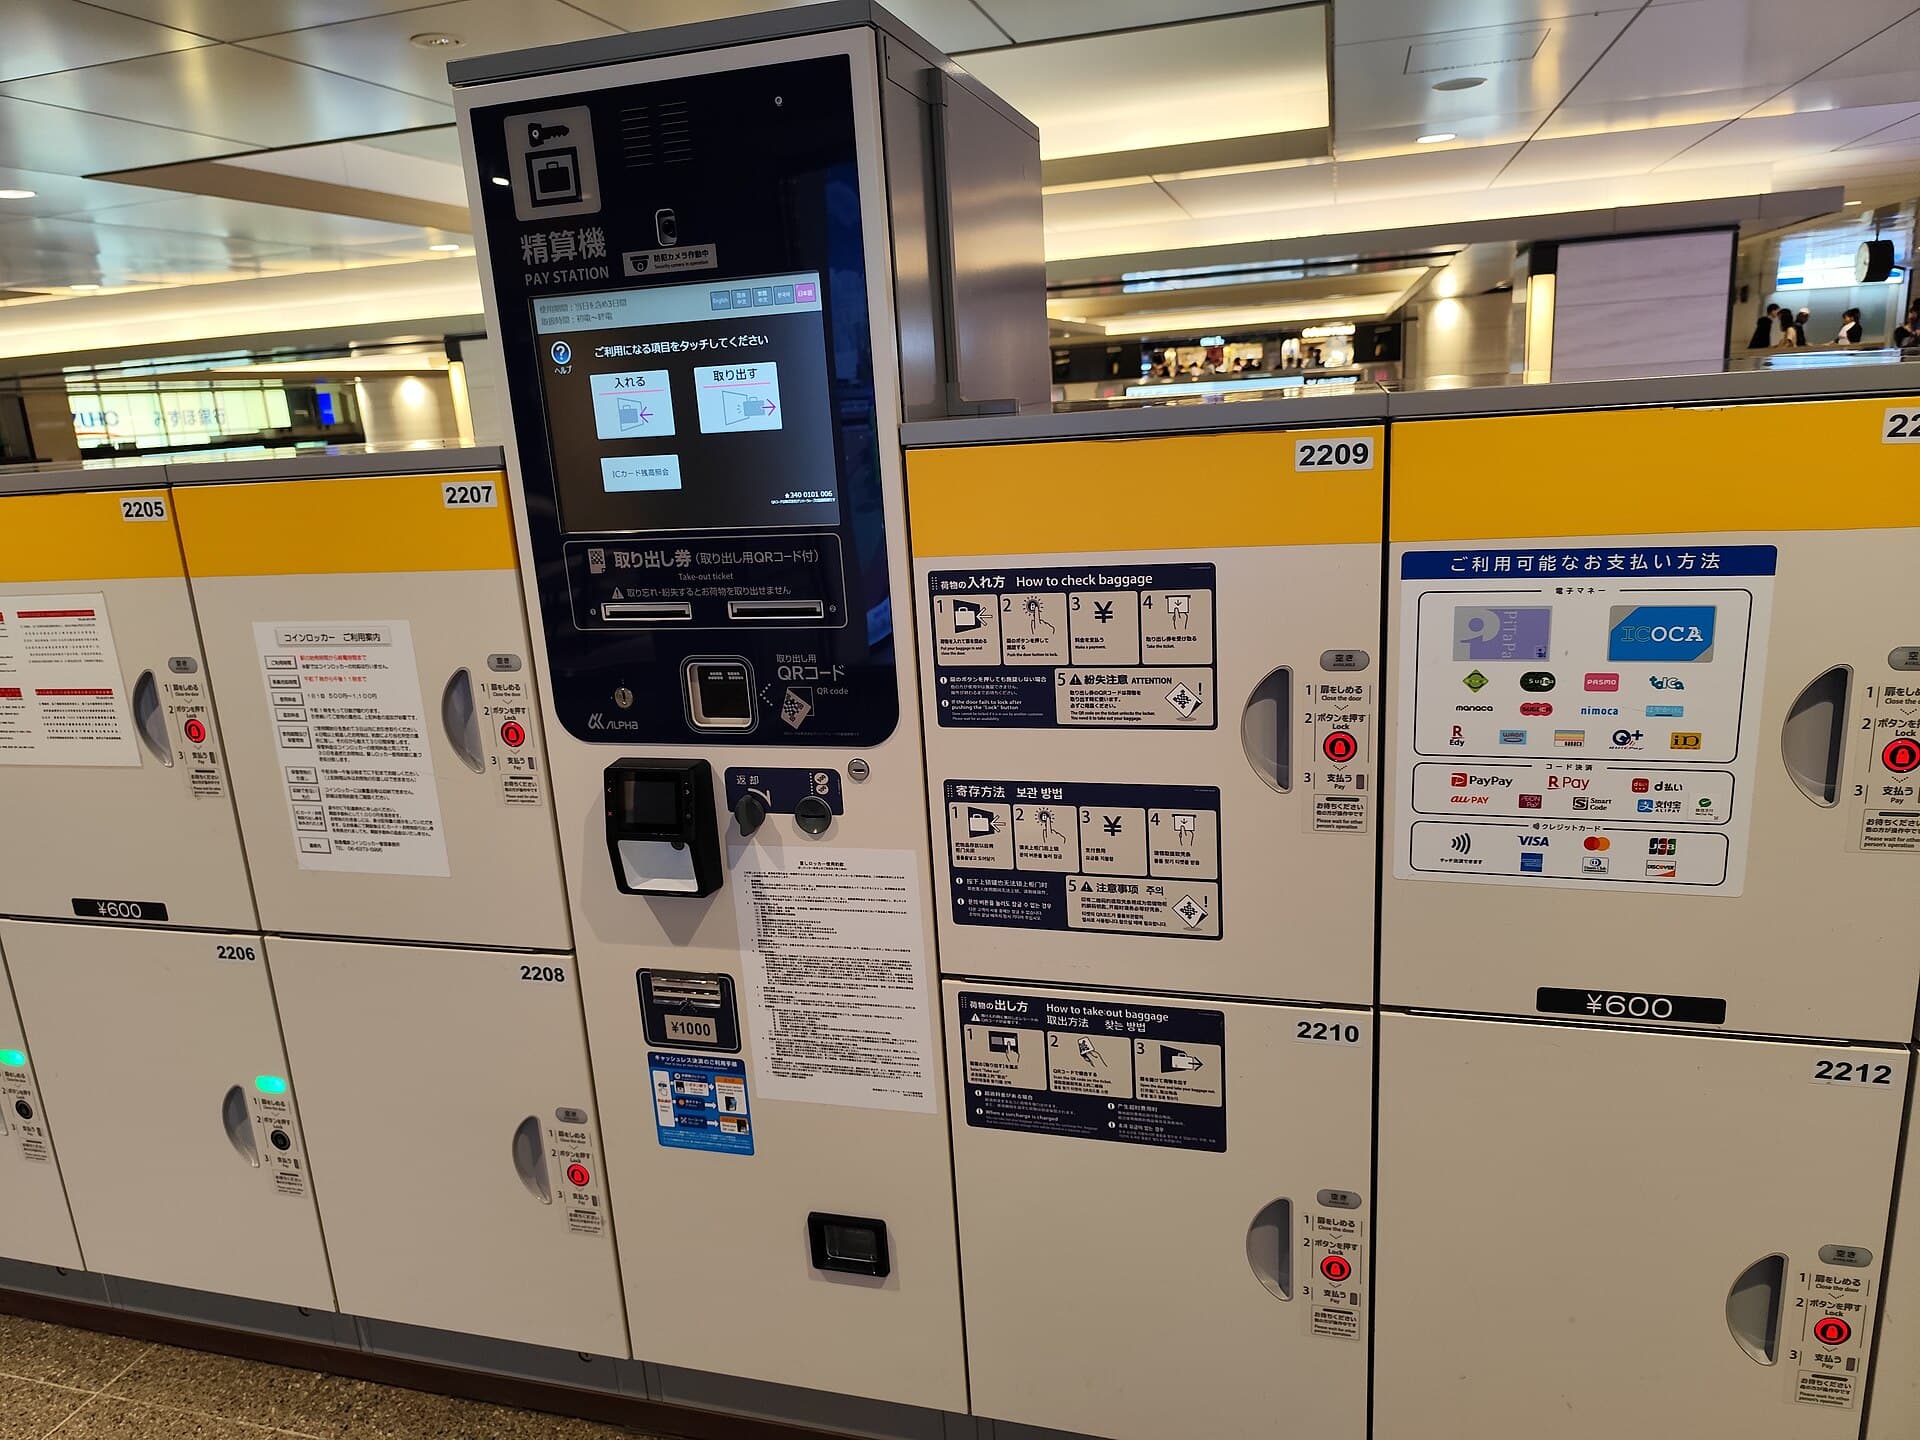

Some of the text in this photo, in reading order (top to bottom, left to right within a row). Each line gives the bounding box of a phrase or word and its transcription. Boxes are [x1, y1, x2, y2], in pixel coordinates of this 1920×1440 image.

[520, 227, 607, 266] 精算機
[525, 266, 609, 286] PAY STATION
[594, 334, 769, 359] ご利用になる項目をタッチしてください
[554, 365, 572, 375] ヘルプ
[713, 367, 757, 383] 取り出す
[614, 376, 646, 389] 入れる
[1299, 442, 1369, 466] 2209
[445, 485, 493, 505] 2207
[122, 501, 165, 519] 2205
[1451, 552, 1721, 572] ご利用可能なお支払い方法
[678, 572, 734, 581] Take-out ticket
[940, 574, 1153, 590] 荷物の入れ方 How to check baggage
[1555, 587, 1606, 595] 電子マネー
[936, 600, 943, 613] 1
[1003, 598, 1012, 612] 2
[1071, 597, 1081, 611] 3
[1143, 595, 1153, 610] 4
[284, 633, 381, 642] コインロッカー ご利用案内
[1502, 610, 1518, 658] PiTaPa
[1621, 626, 1704, 642] ICOCA
[776, 654, 816, 664] 取り出し用
[777, 664, 845, 682] QRコード
[1058, 673, 1172, 686] 5 紛失注意 ATTENTION
[491, 683, 521, 692] 扉をしめる
[816, 687, 849, 695] QR code
[1320, 685, 1364, 694] 扉をしめる
[492, 707, 526, 715] ボタンを押す
[1581, 706, 1619, 716] nimoca
[1304, 713, 1366, 724] 2 ボタンを押す
[1861, 718, 1872, 730] 2
[1453, 725, 1462, 737] R
[1449, 739, 1465, 747] Edy
[1673, 735, 1699, 747] iD
[507, 757, 525, 765] 支払う
[1546, 763, 1593, 771] コード決済
[1303, 773, 1352, 783] 3 支払う
[1469, 775, 1513, 788] PayPay
[1548, 775, 1590, 790] R Pay
[956, 785, 1063, 800] 寄存方法 보관 방법
[1334, 783, 1345, 791] Pay
[1654, 781, 1683, 792] d払い
[1854, 785, 1914, 796] 3 支払う
[1450, 795, 1489, 804] au PAY
[1655, 800, 1682, 809] 支付宝
[1890, 797, 1904, 805] Pay
[1316, 802, 1364, 811] お待ちください
[1016, 808, 1025, 821] 2
[1082, 811, 1091, 823] 3
[1150, 813, 1161, 826] 4
[1542, 824, 1601, 832] クレジットカード
[1517, 835, 1550, 847] VISA
[1649, 840, 1676, 853] JCB
[1068, 880, 1164, 896] 5 注意事项 주의
[97, 901, 142, 919] ¥600
[216, 945, 256, 961] 2206
[520, 965, 565, 982] 2208
[969, 999, 1169, 1023] 荷物の出し方 How to take out baggage
[1587, 993, 1673, 1019] ¥600
[671, 1020, 711, 1037] ¥1000
[1047, 1015, 1089, 1028] 取出方法
[1104, 1019, 1124, 1031] 찾는
[1127, 1021, 1146, 1033] 방법
[1297, 1021, 1359, 1042] 2210
[1050, 1034, 1059, 1048] 2
[1136, 1042, 1145, 1055] 3
[1815, 1060, 1893, 1085] 2212
[1317, 1216, 1356, 1228] 扉をしめる
[1303, 1238, 1358, 1251] 2 ボタンを押す
[1328, 1248, 1344, 1256] Lock
[1814, 1274, 1861, 1287] 扉をしめる
[1302, 1286, 1346, 1299] 3 支払う
[1795, 1297, 1862, 1312] 2 ボタンを押す
[1824, 1309, 1844, 1317] Lock
[1789, 1350, 1842, 1364] 3 支払う
